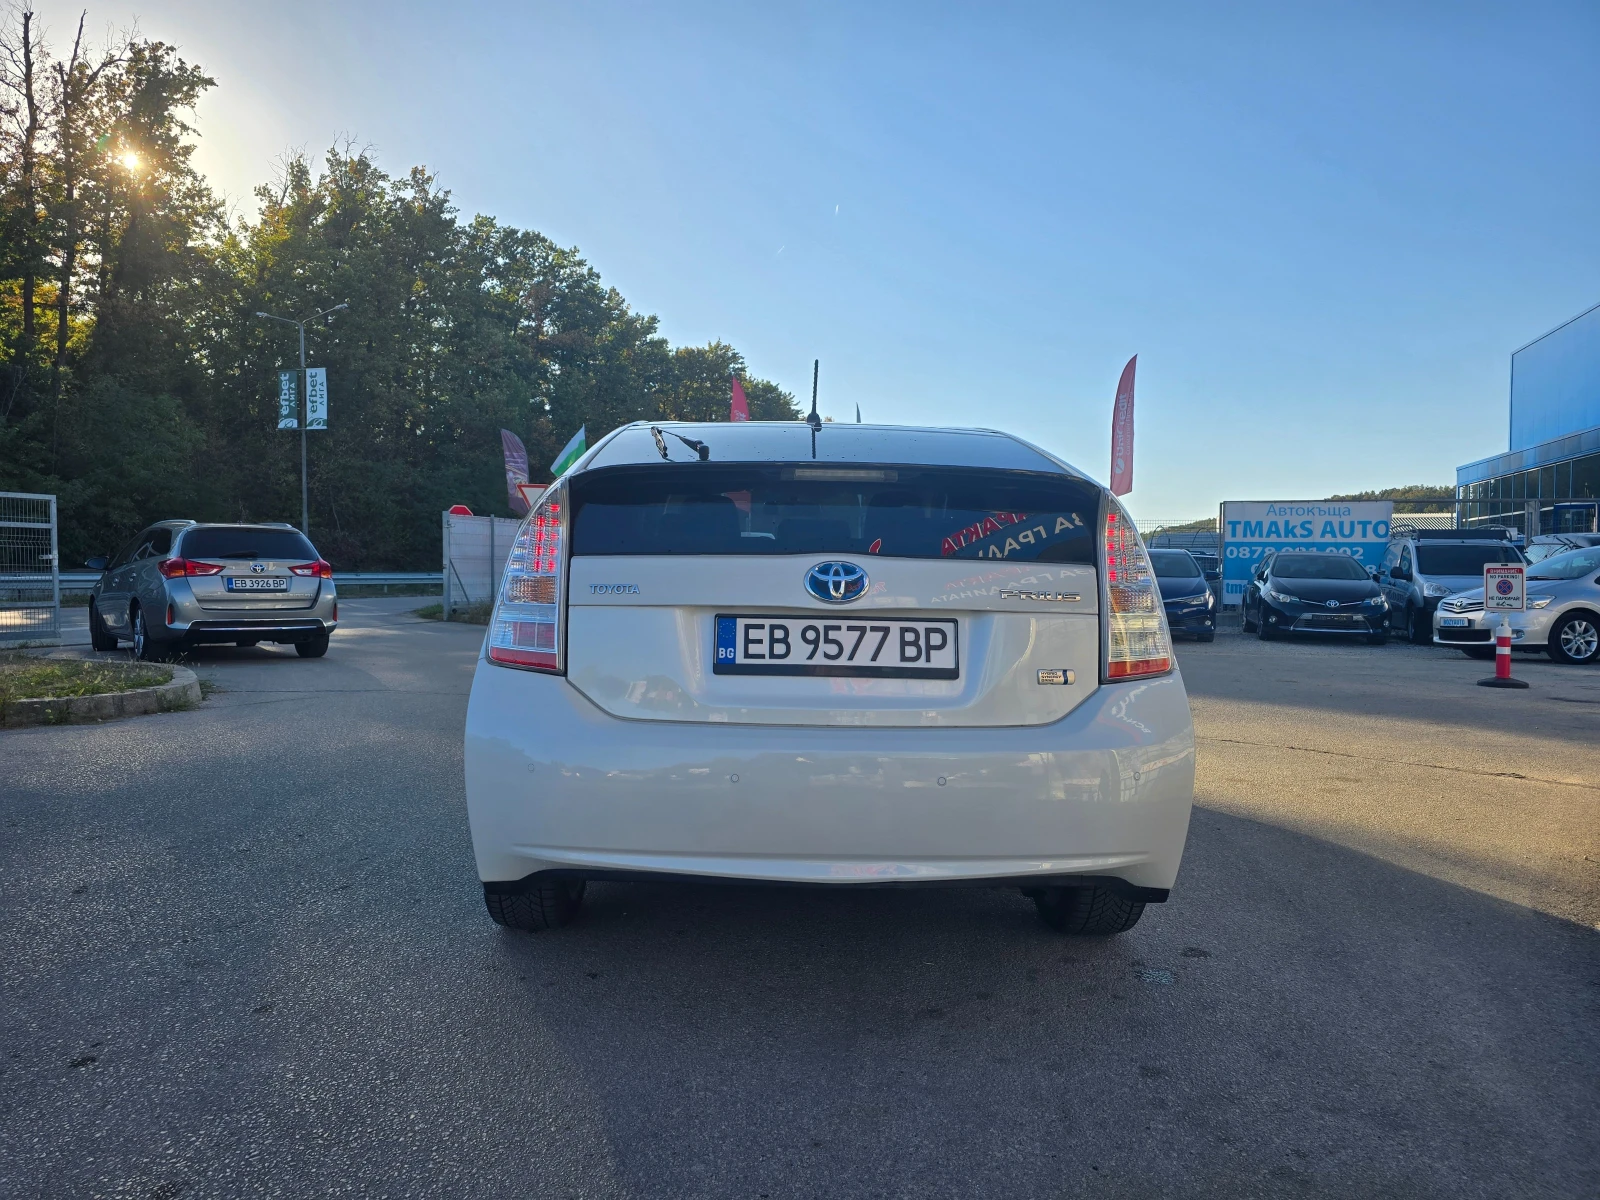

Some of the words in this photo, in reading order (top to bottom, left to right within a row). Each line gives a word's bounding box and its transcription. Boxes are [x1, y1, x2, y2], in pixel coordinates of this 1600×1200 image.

[280, 373, 289, 416] efbet
[309, 371, 318, 414] efbet
[1266, 504, 1351, 518] Автокъща
[1227, 519, 1314, 539] TMAkS
[1319, 520, 1390, 539] AUTO
[234, 579, 247, 588] EB
[249, 579, 271, 588] 3926
[273, 579, 285, 588] BP
[589, 584, 640, 594] TOYOTA
[1000, 588, 1081, 602] PRIUS
[743, 623, 792, 660] EB
[800, 624, 891, 662] 9577
[899, 626, 948, 663] BP
[718, 647, 735, 659] BG
